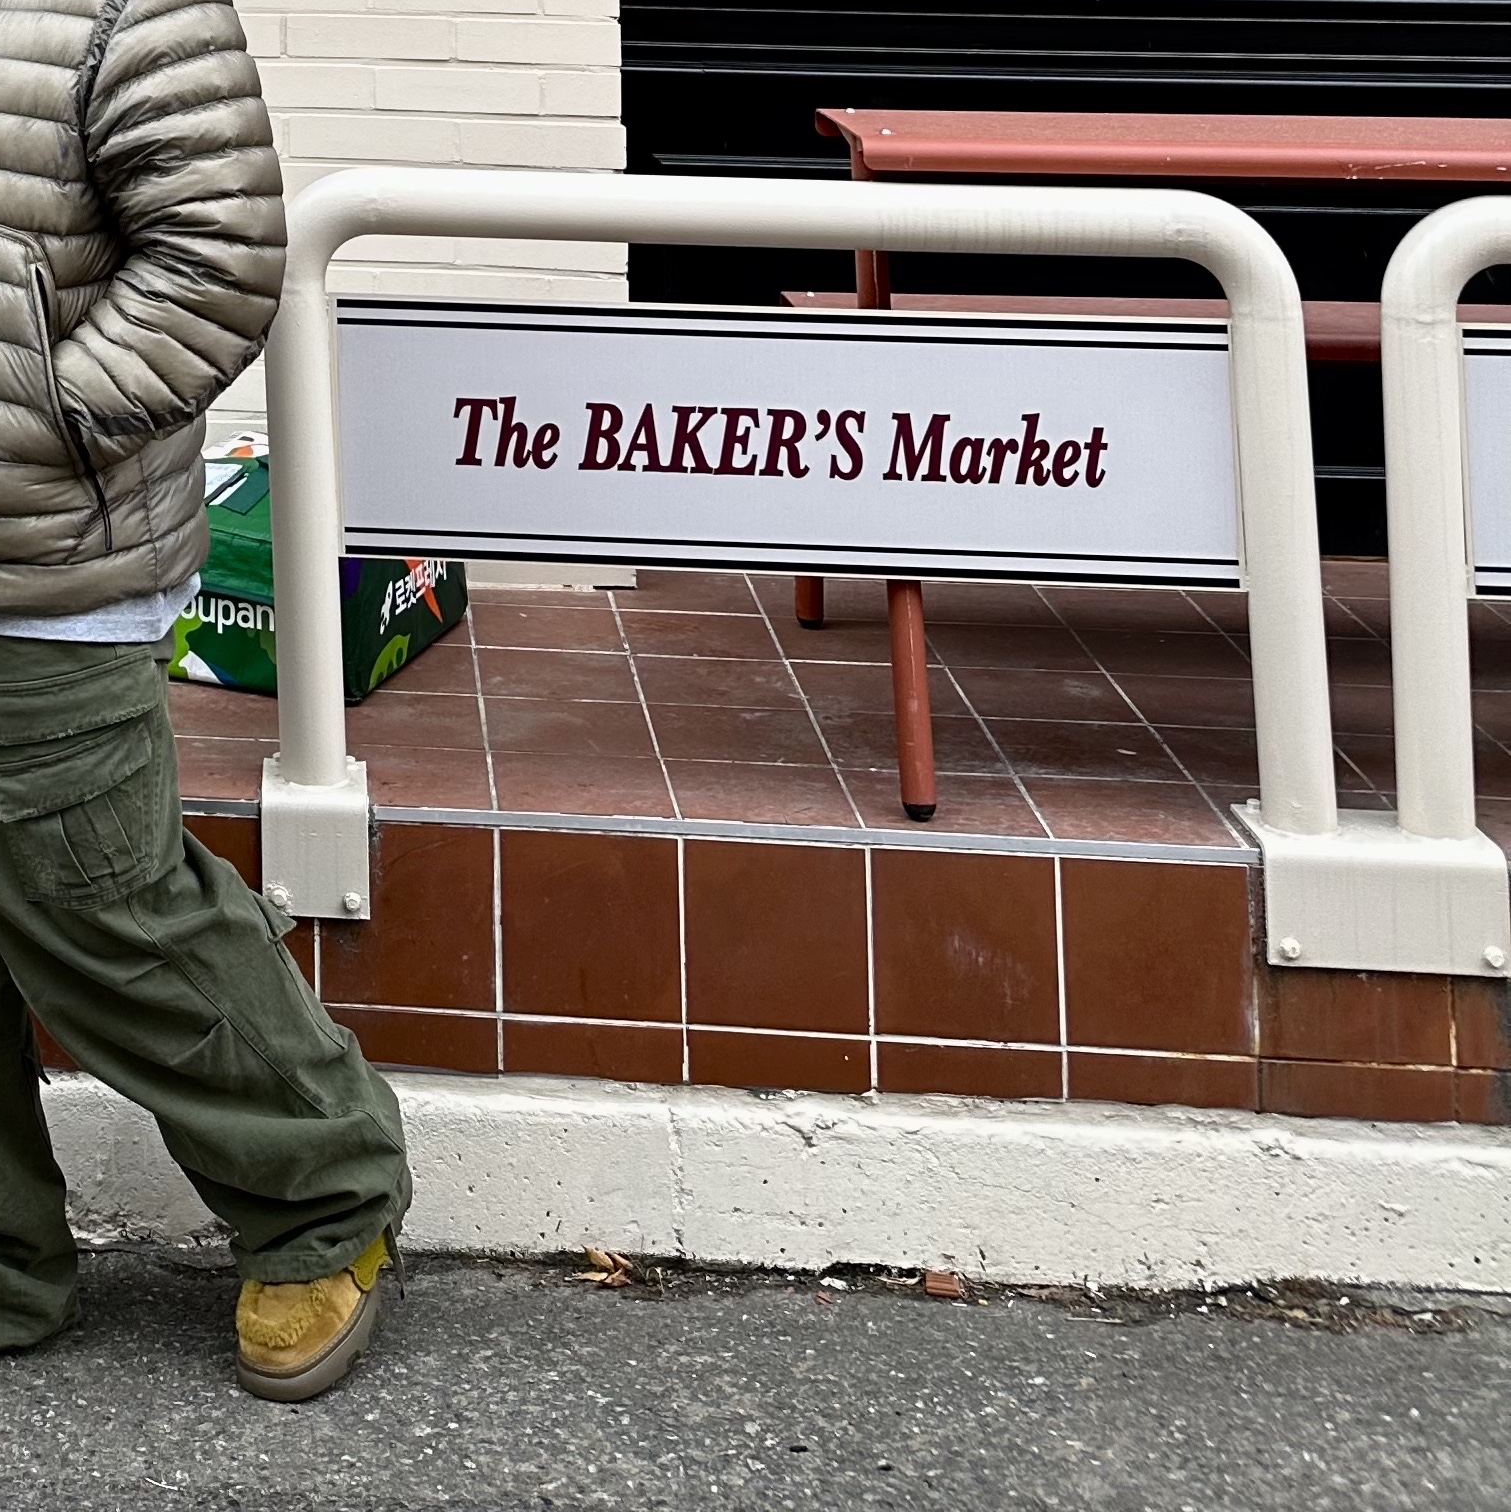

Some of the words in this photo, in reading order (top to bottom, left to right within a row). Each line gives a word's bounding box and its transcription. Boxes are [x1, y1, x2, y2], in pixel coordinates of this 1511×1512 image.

[453, 395, 561, 471] The
[578, 401, 867, 481] BAKER'S
[882, 412, 1110, 489] Market
